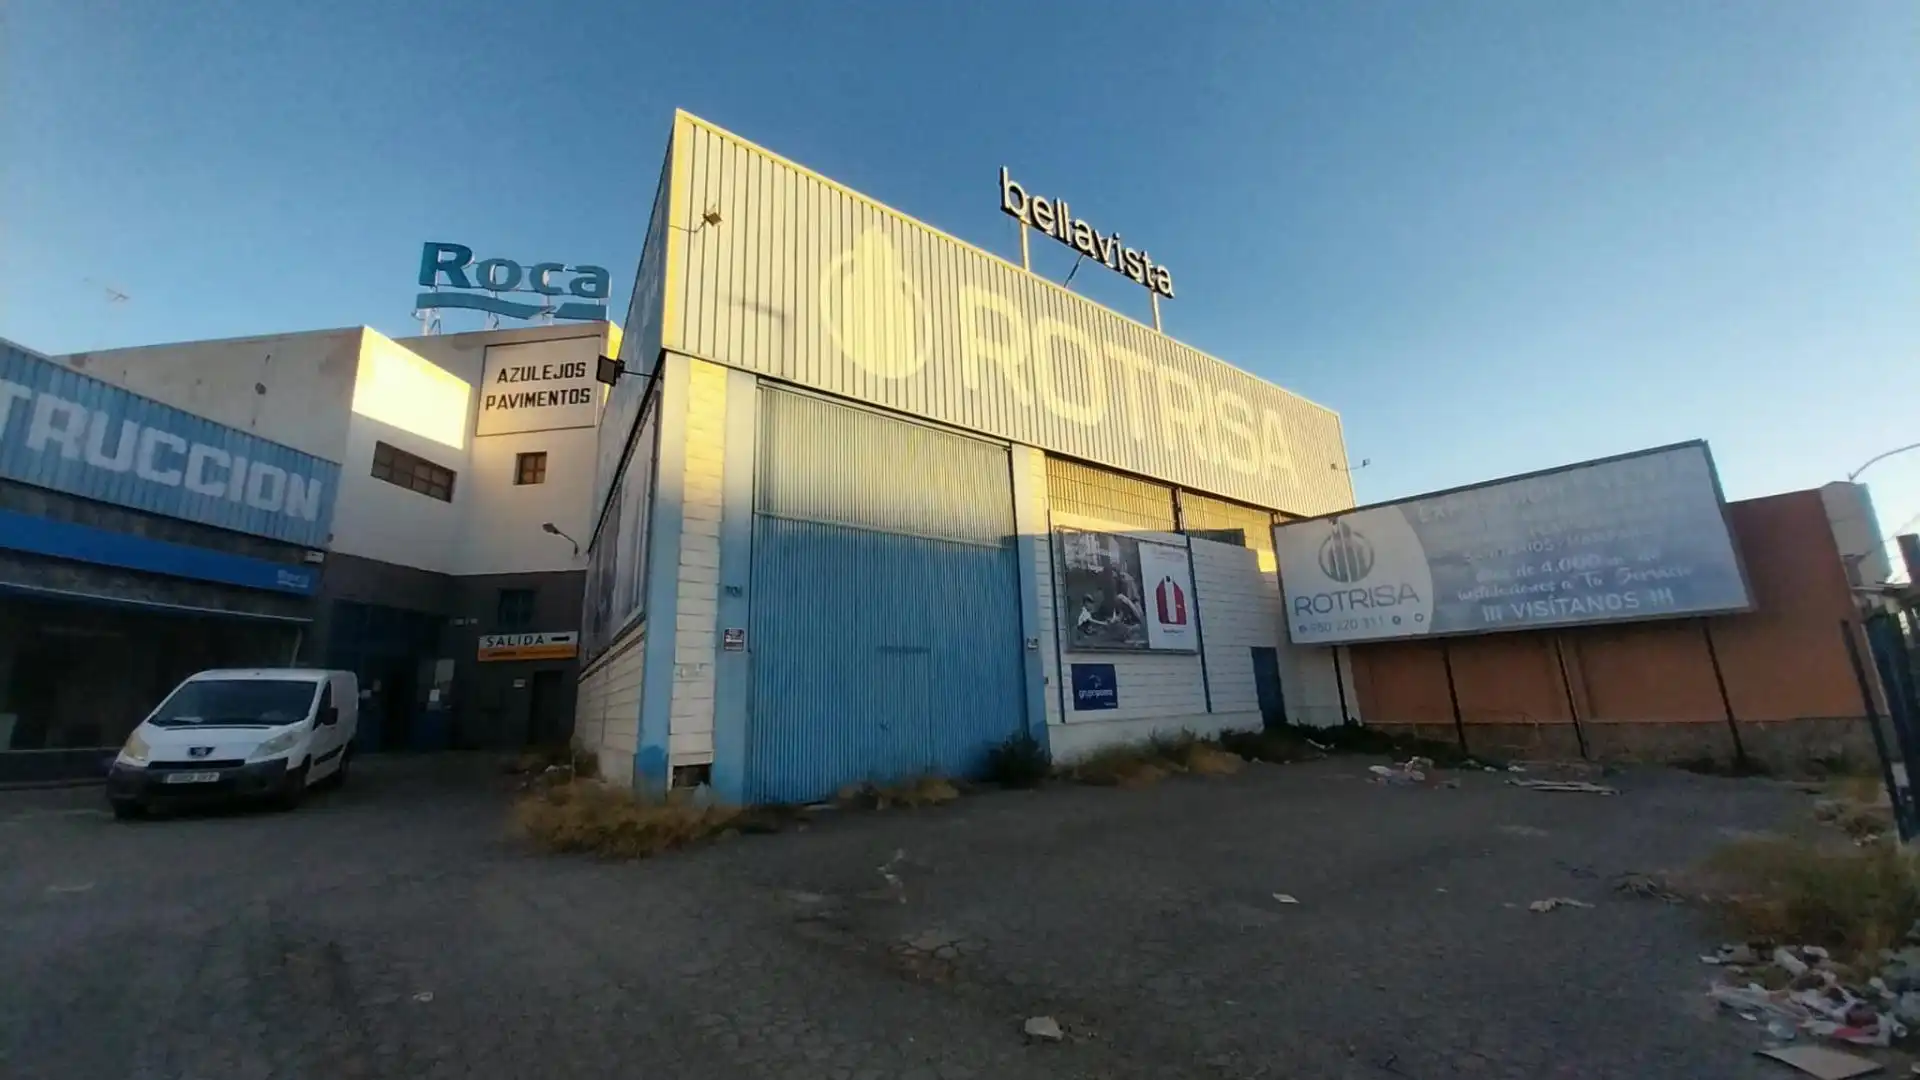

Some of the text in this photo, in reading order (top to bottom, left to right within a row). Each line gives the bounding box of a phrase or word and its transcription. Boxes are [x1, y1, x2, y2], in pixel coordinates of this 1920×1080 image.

[1000, 165, 1174, 299] bellavista
[419, 242, 610, 298] Roca
[497, 362, 586, 383] AZULEJOS
[959, 285, 1301, 489] ROTRISA
[485, 388, 591, 411] PAVIMENTOS
[1294, 583, 1420, 616] ROTRISA
[1510, 591, 1640, 619] VISÍTANOS
[486, 634, 545, 647] SALIDA
